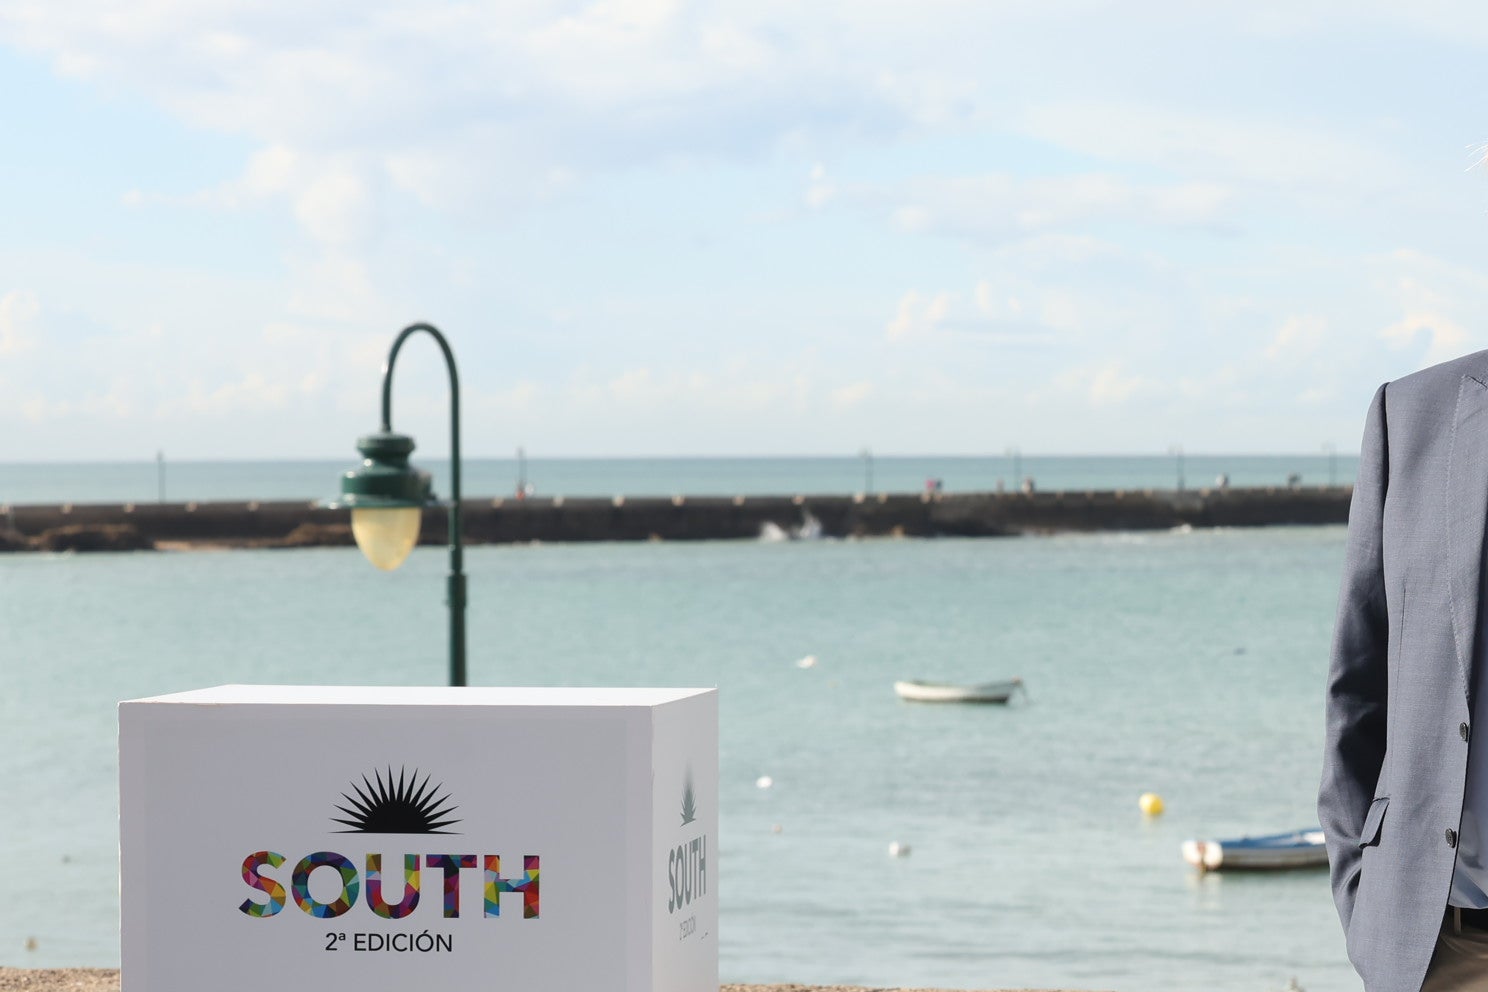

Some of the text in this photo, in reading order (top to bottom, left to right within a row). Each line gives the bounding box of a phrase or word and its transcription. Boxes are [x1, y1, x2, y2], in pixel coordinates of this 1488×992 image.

[238, 851, 540, 919] SOUTH
[668, 834, 707, 914] SOUTH
[325, 930, 453, 952] 2ª EDICIÓN
